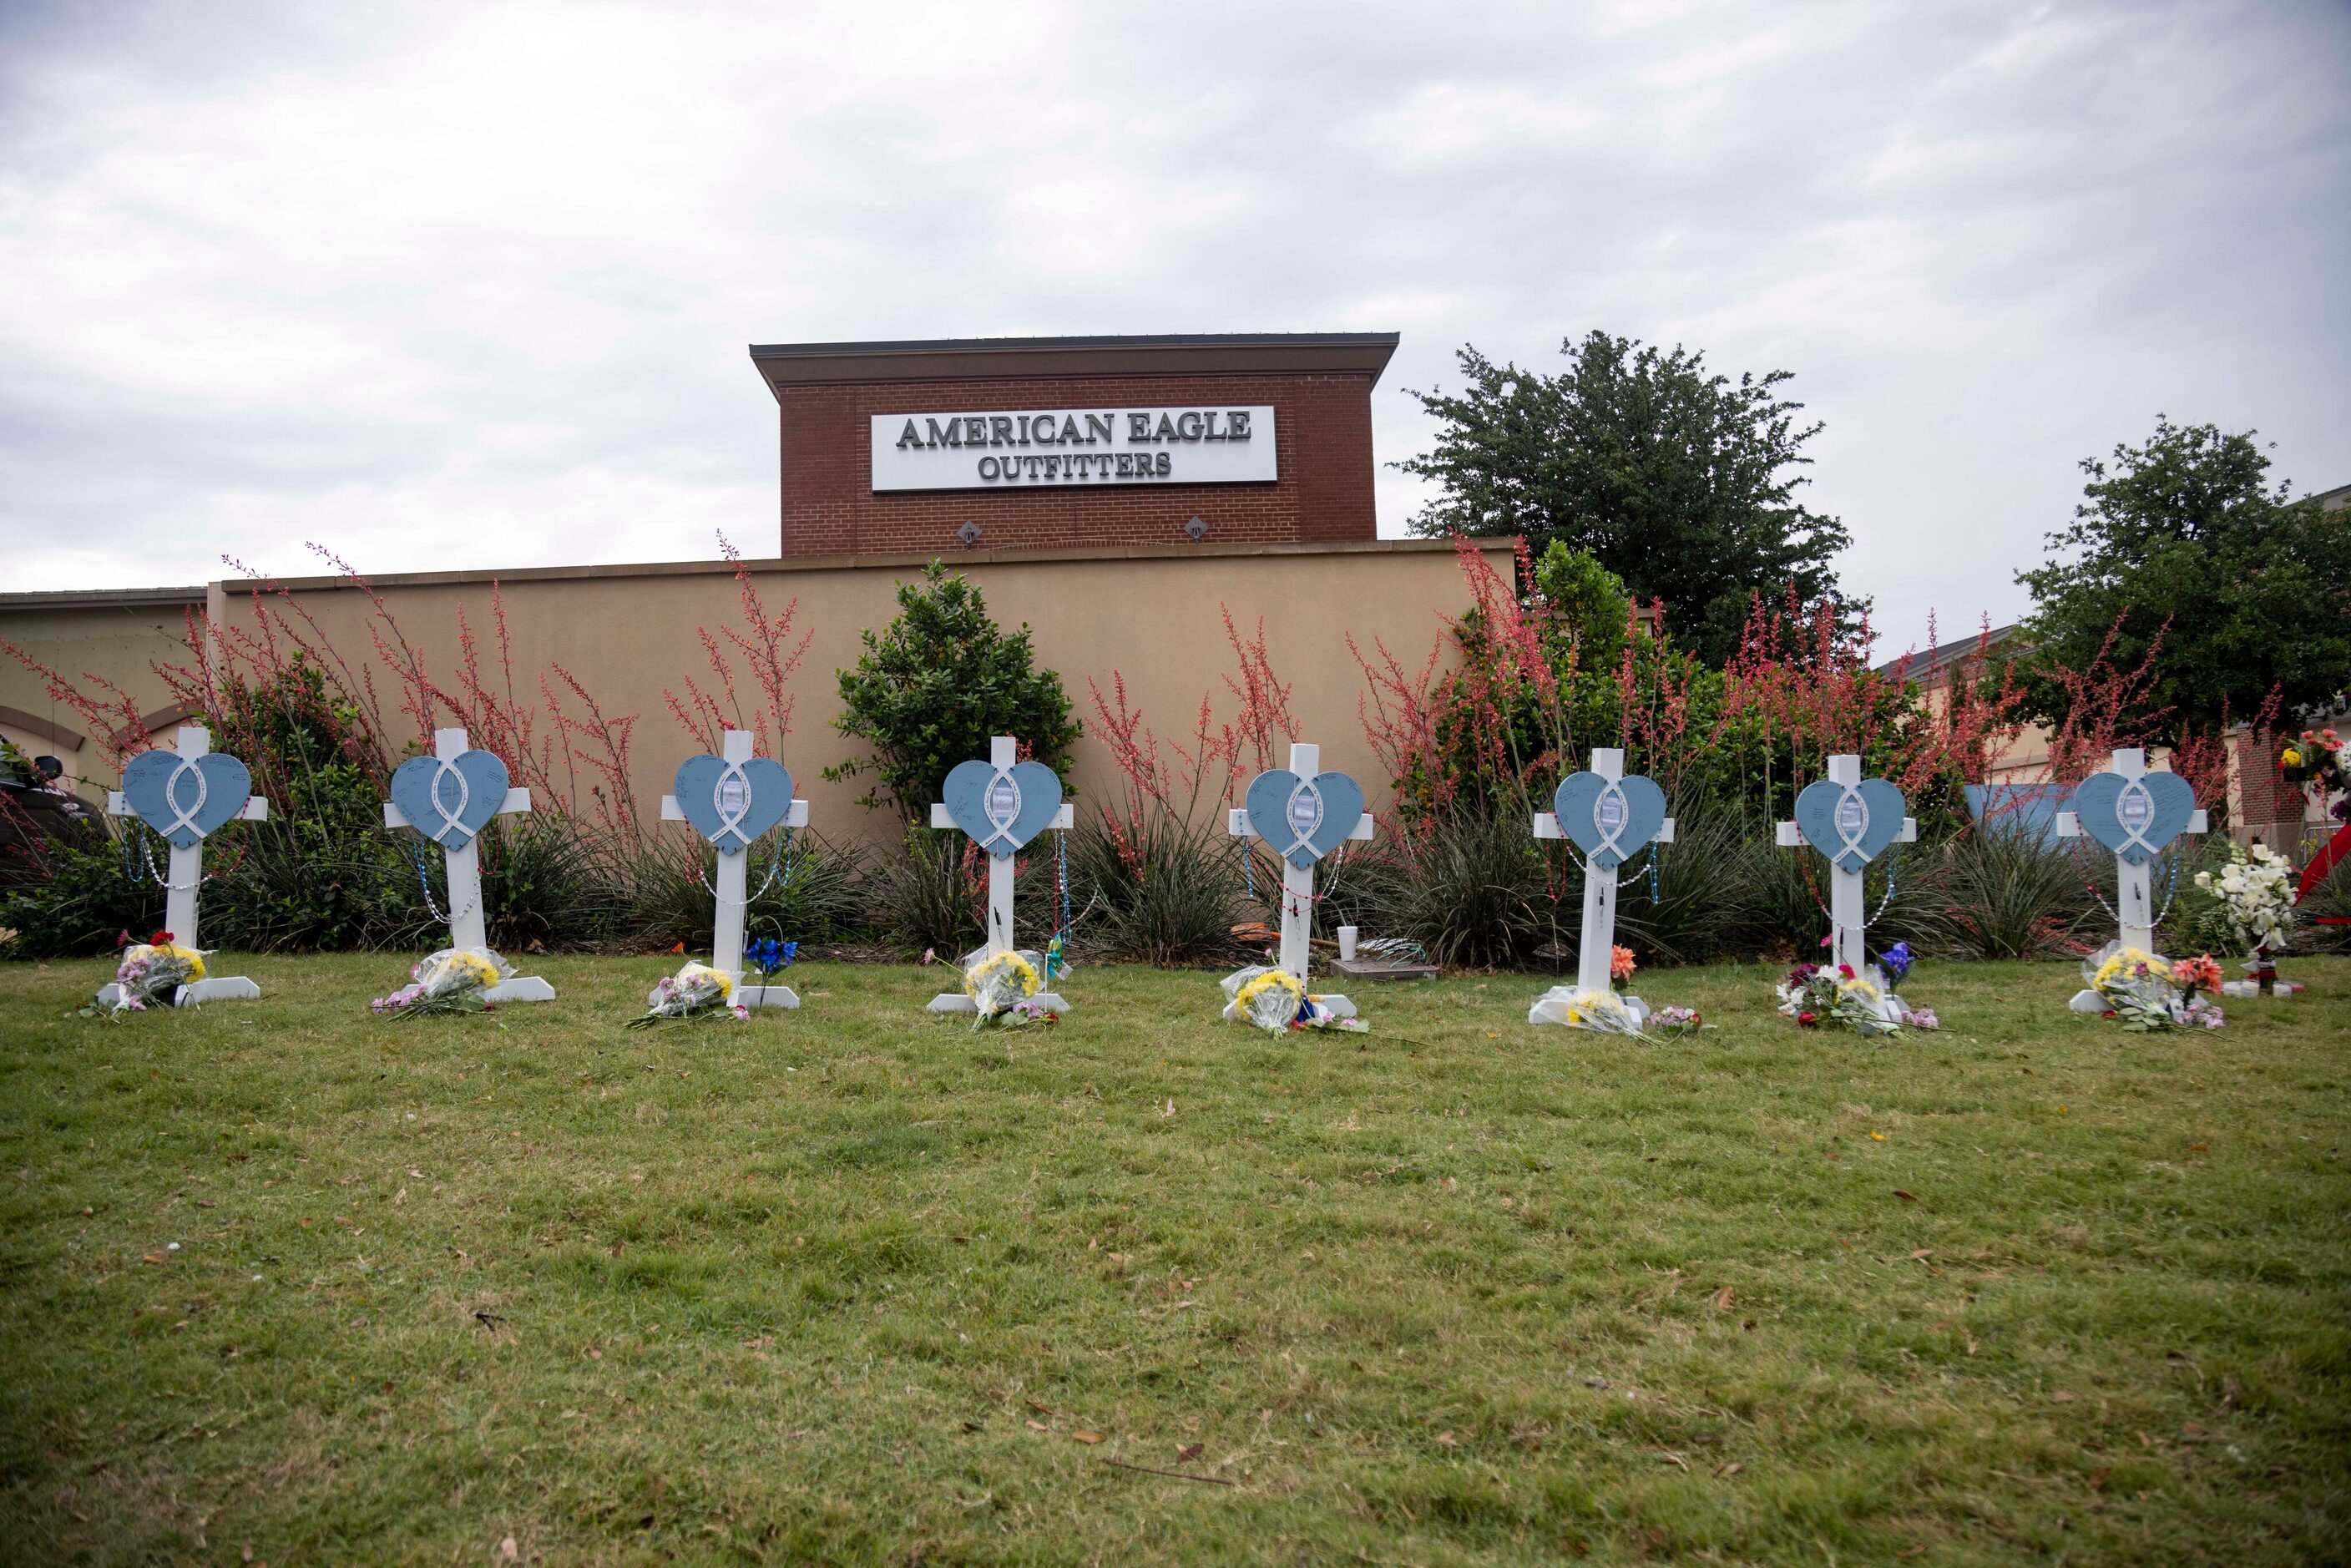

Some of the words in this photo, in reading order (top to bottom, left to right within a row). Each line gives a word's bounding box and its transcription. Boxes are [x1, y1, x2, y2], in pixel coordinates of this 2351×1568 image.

[896, 413, 1115, 447] AMERICAN
[1128, 411, 1251, 442] EAGLE
[978, 452, 1171, 479] OUTFITTERS
